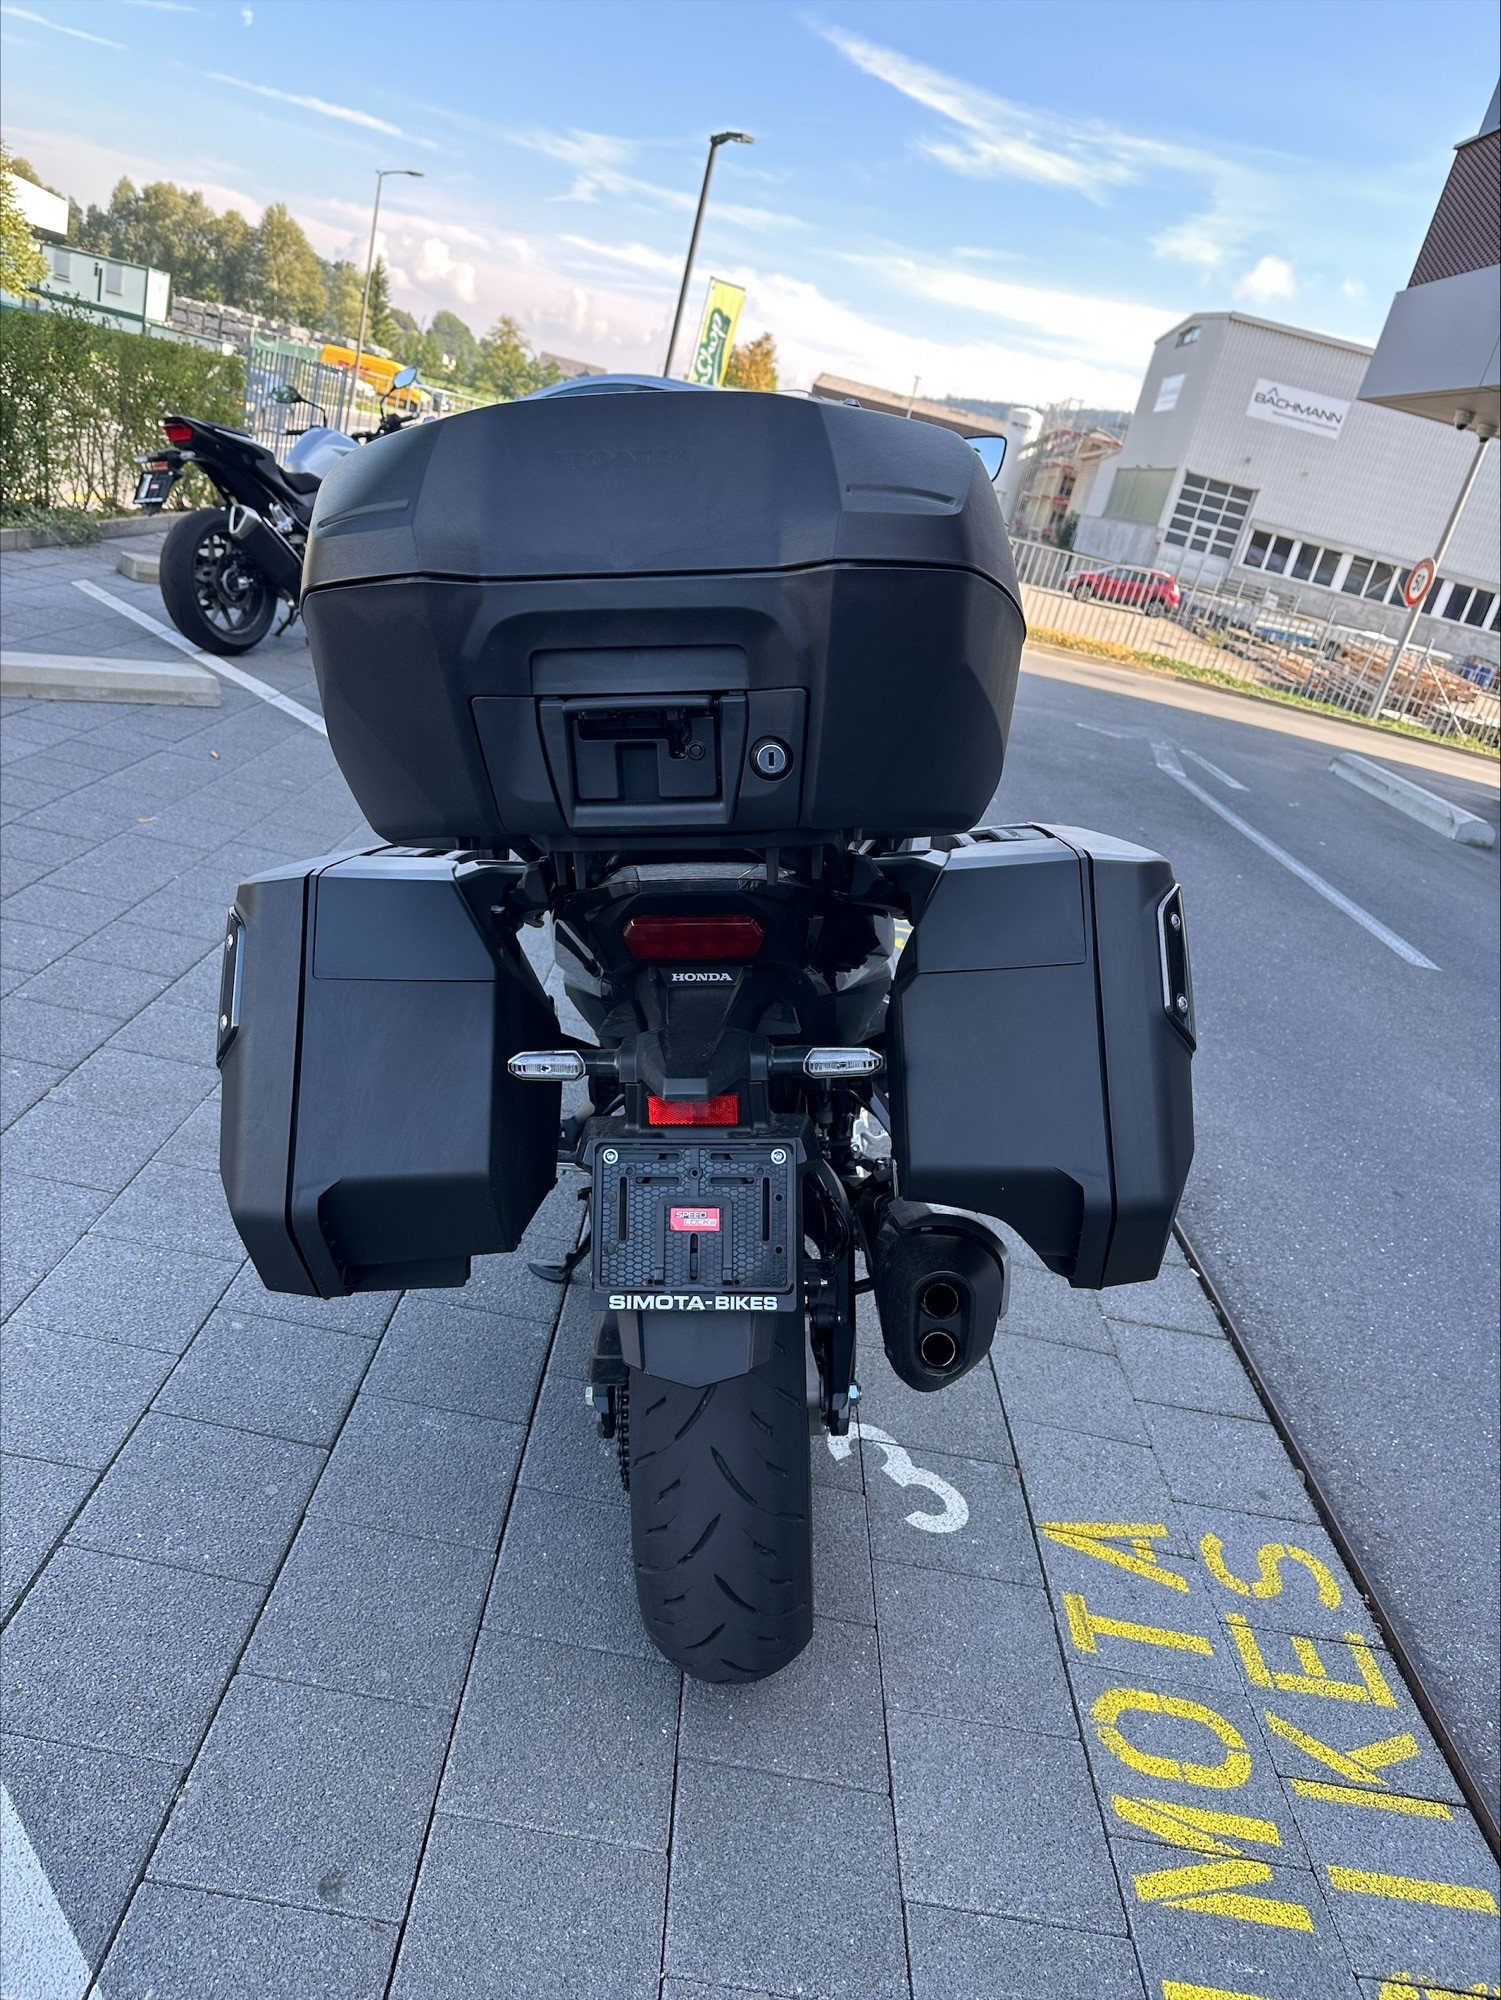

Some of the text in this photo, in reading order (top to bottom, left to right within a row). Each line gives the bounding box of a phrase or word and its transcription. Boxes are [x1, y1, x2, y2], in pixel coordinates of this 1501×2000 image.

[1254, 391, 1343, 424] BACHMANN
[671, 972, 733, 982] HONDA
[608, 1295, 778, 1311] SIMOTA-BIKES
[827, 1422, 970, 1533] 3
[1037, 1521, 1315, 2000] MOTA
